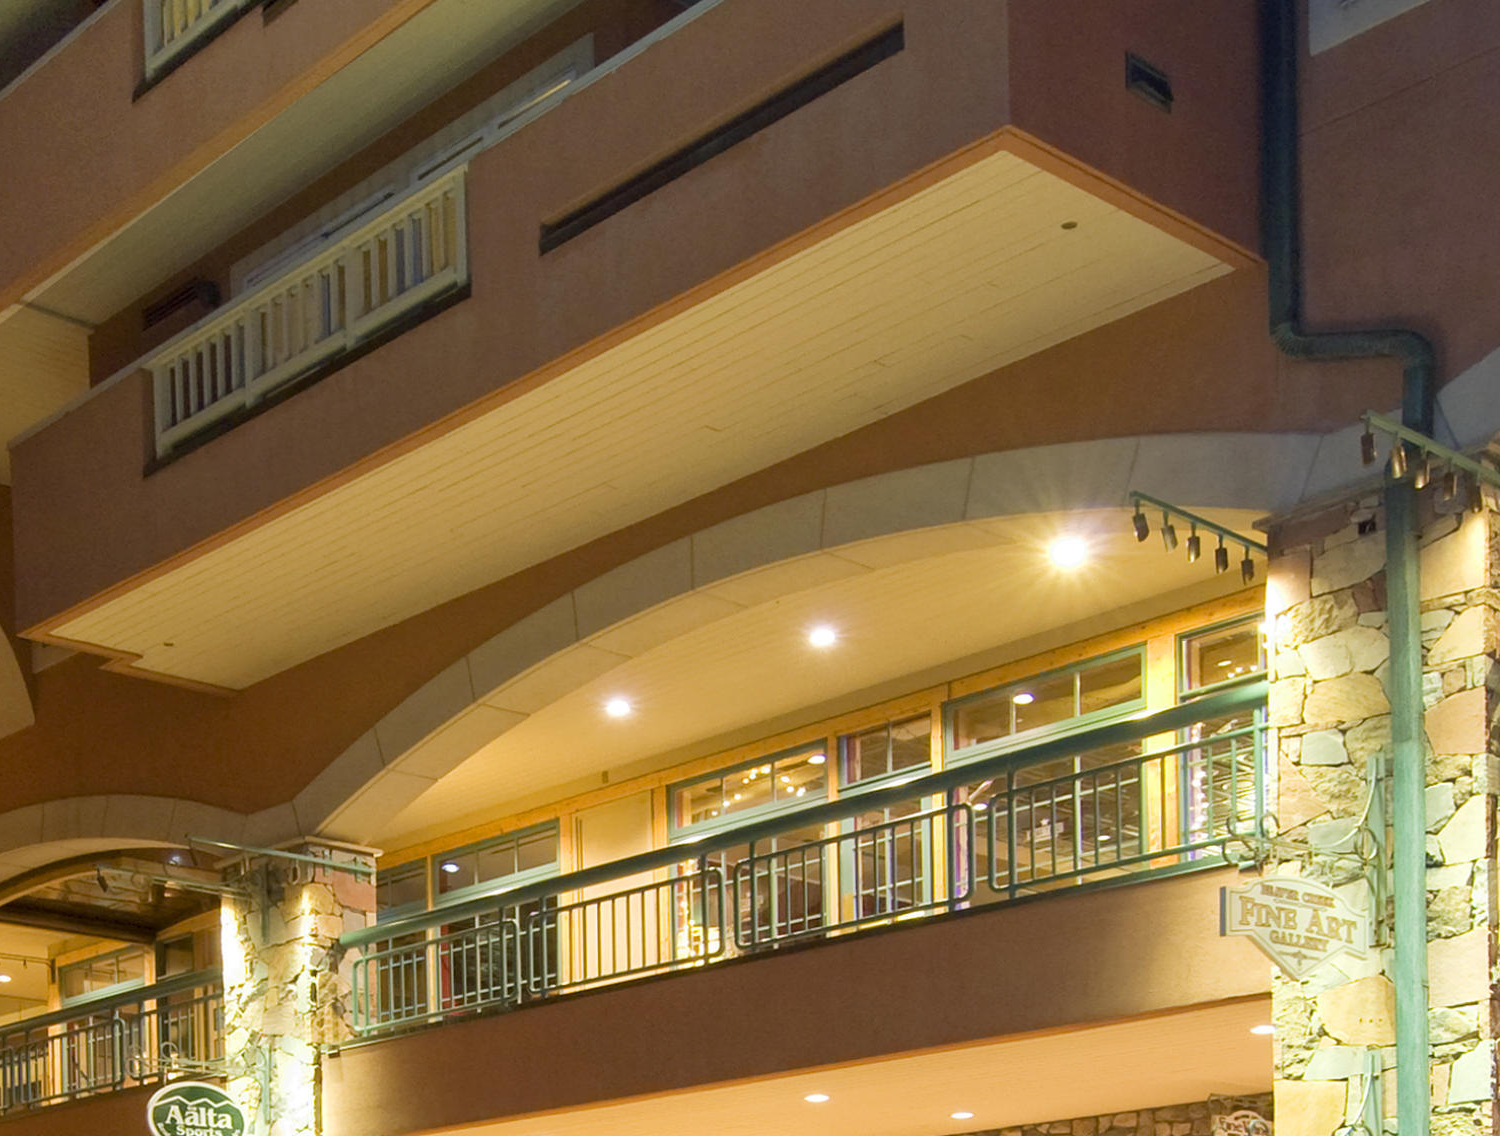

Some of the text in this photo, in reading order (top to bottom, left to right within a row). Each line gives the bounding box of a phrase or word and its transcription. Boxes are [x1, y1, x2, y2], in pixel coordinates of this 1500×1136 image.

[1239, 896, 1358, 944] FINE ART
[1269, 929, 1329, 952] GALLERY
